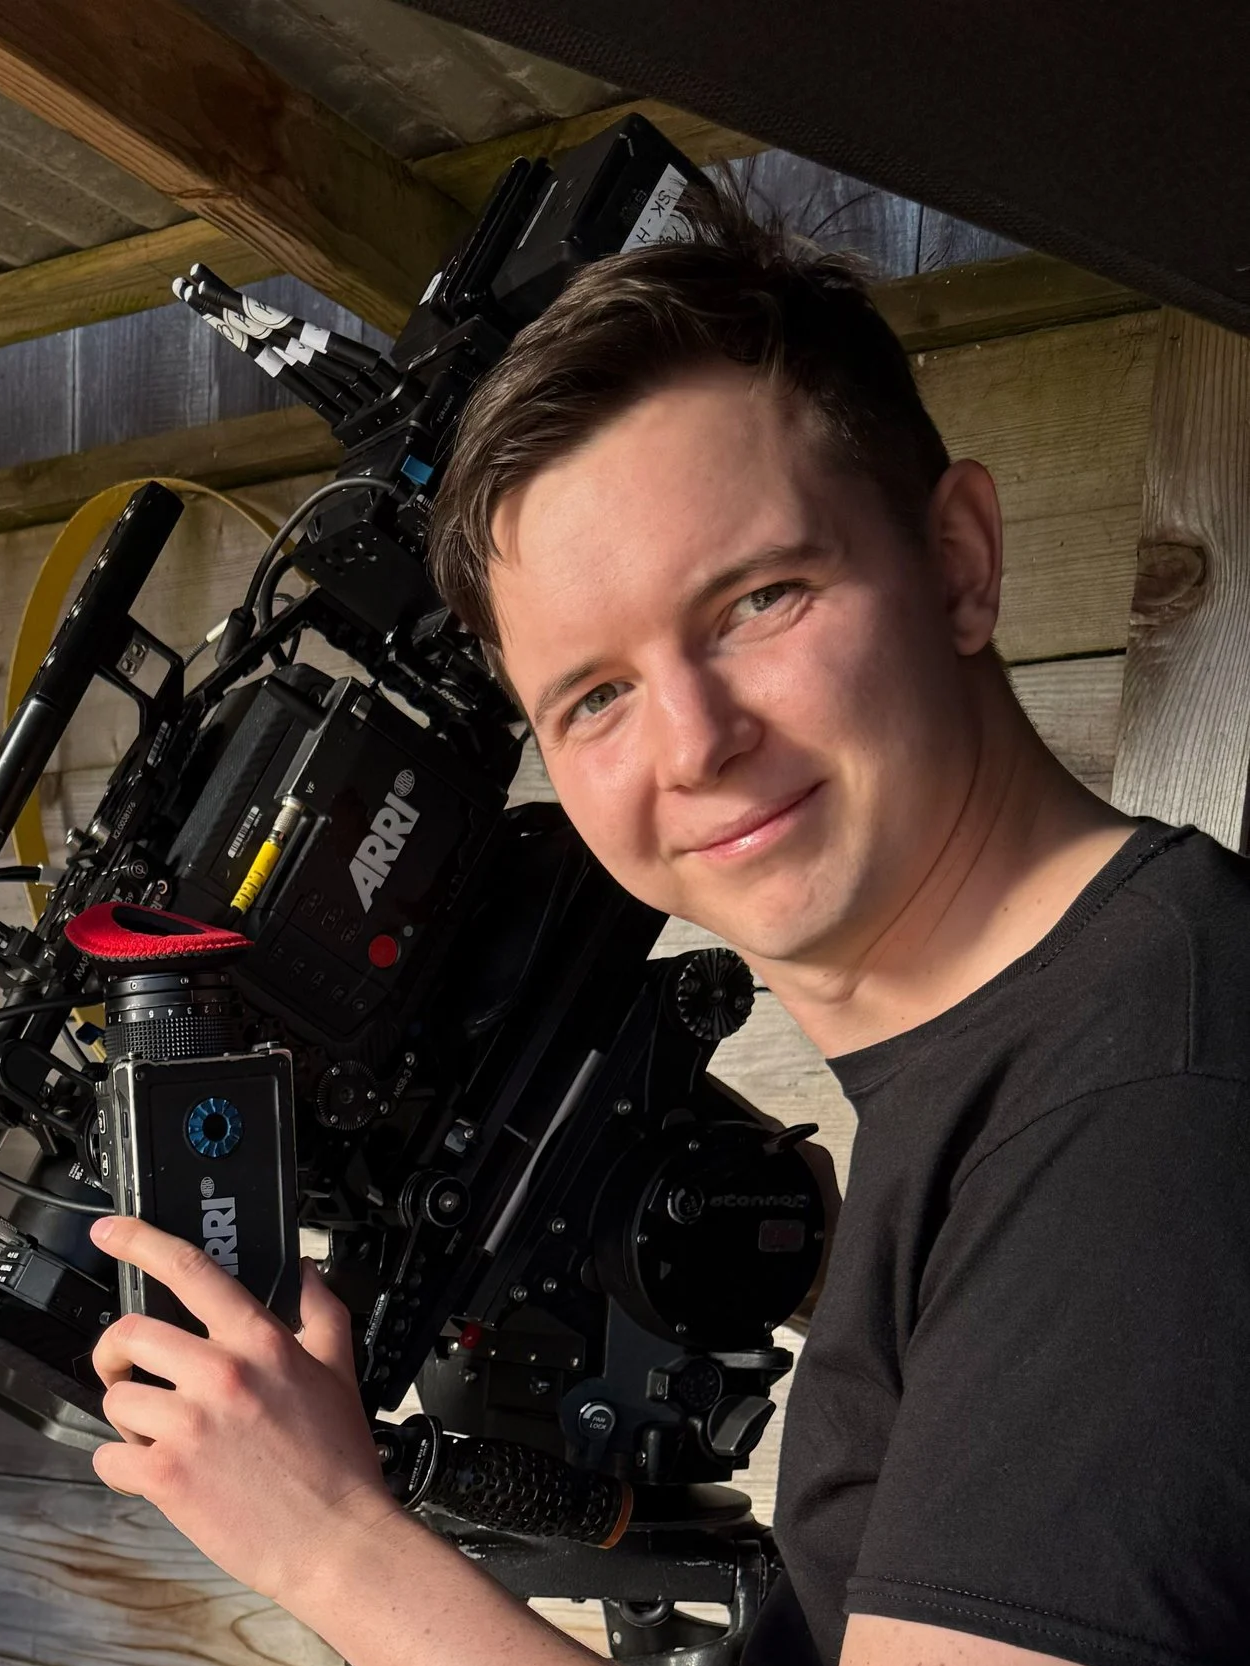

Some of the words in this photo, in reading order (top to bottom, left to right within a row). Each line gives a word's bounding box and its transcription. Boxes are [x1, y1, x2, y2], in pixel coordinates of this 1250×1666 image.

[305, 780, 317, 795] VF
[348, 791, 421, 915] ARRI
[200, 1197, 239, 1277] RRI
